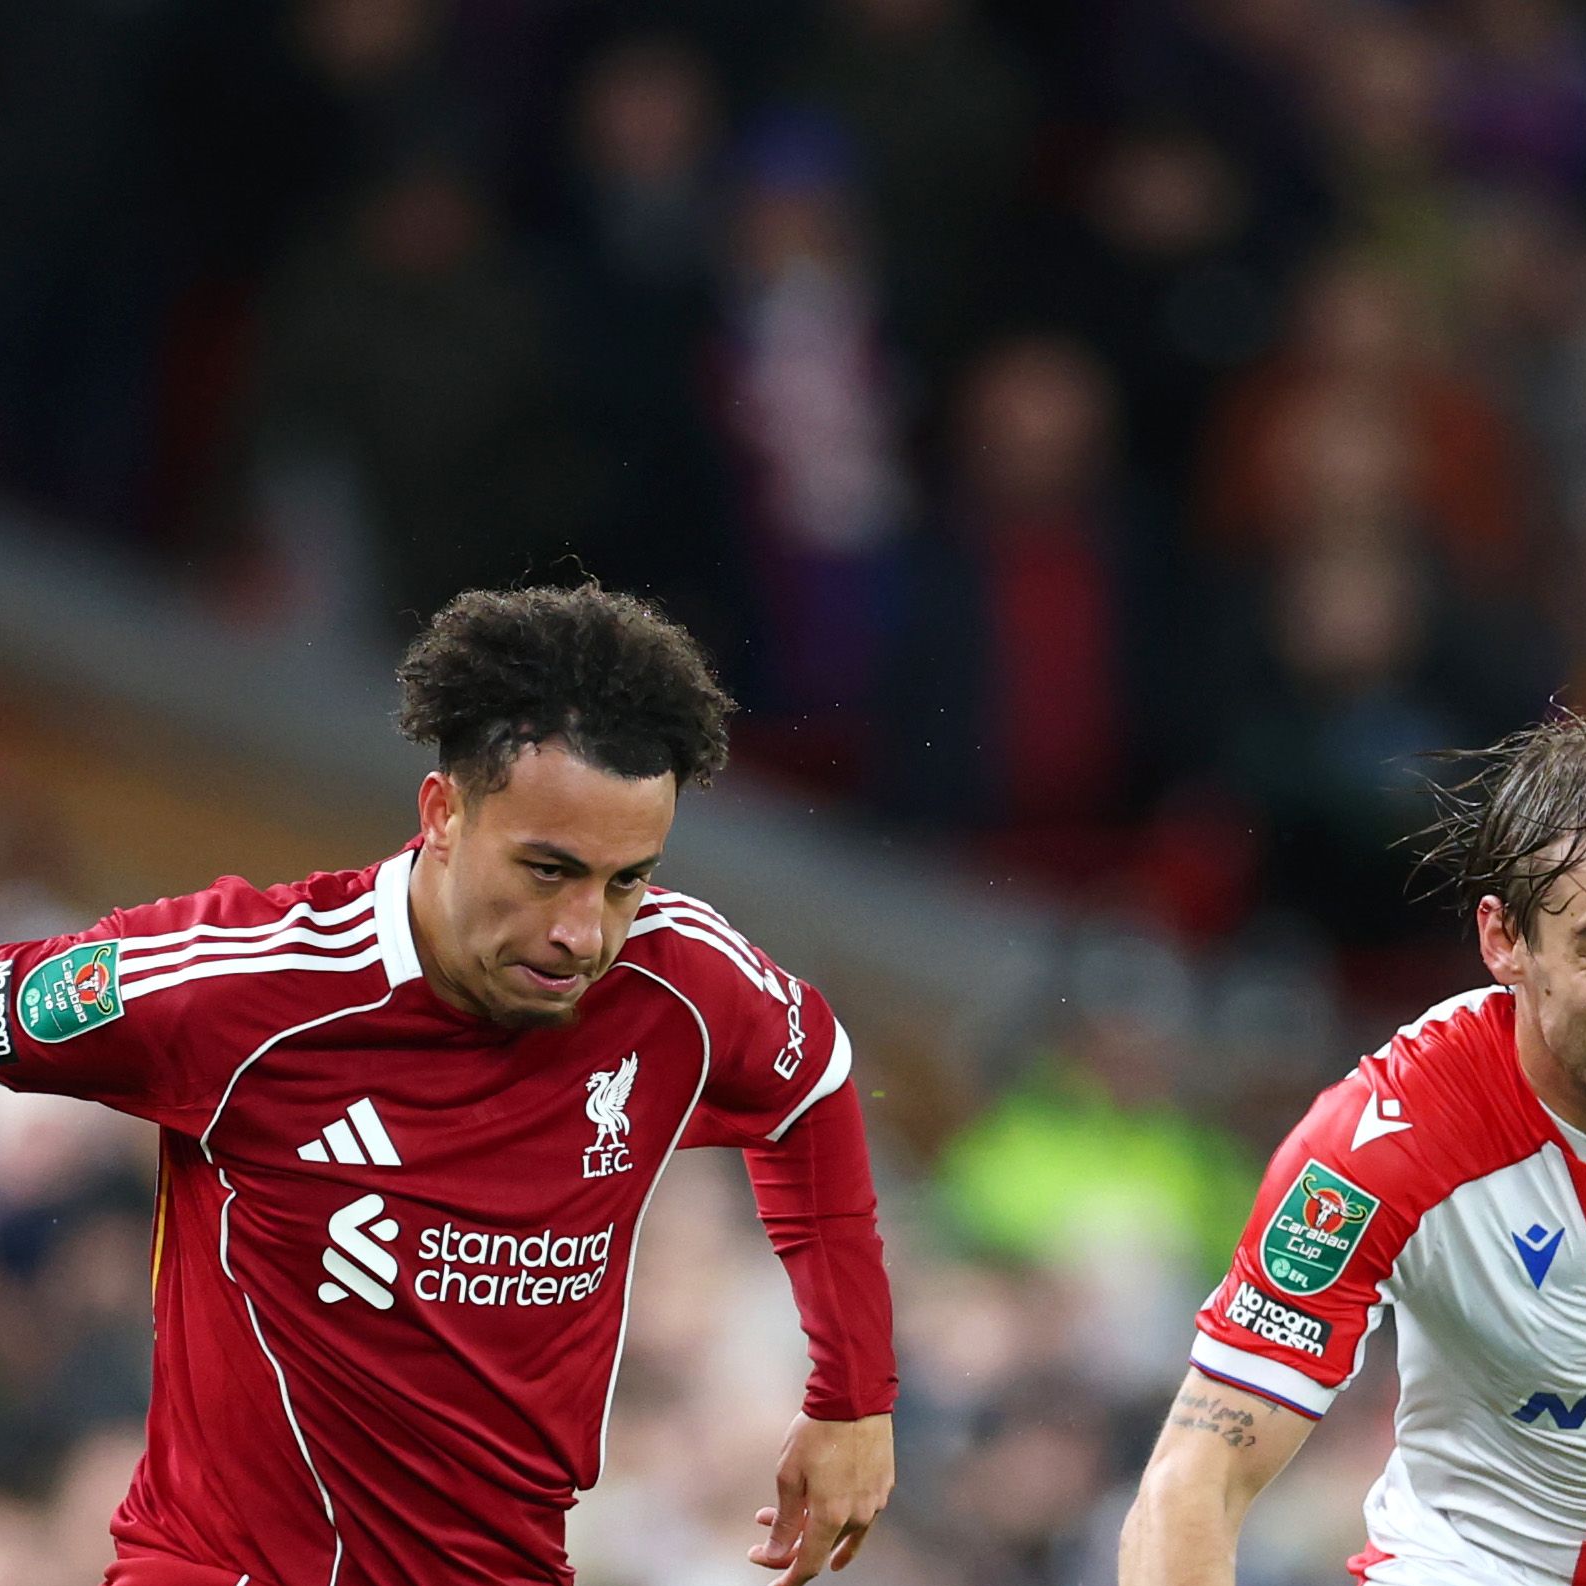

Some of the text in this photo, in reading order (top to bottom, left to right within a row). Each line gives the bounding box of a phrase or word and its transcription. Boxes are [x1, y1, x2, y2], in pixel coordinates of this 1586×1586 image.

[53, 980, 68, 1011] Cup
[62, 959, 87, 1023] Carabao
[418, 1222, 614, 1268] standard
[1276, 1215, 1350, 1251] Carabao
[1286, 1236, 1322, 1260] Cup
[414, 1257, 609, 1306] chartered
[1288, 1268, 1309, 1289] EFL
[1225, 1300, 1324, 1358] for racism
[1234, 1281, 1322, 1341] No room
